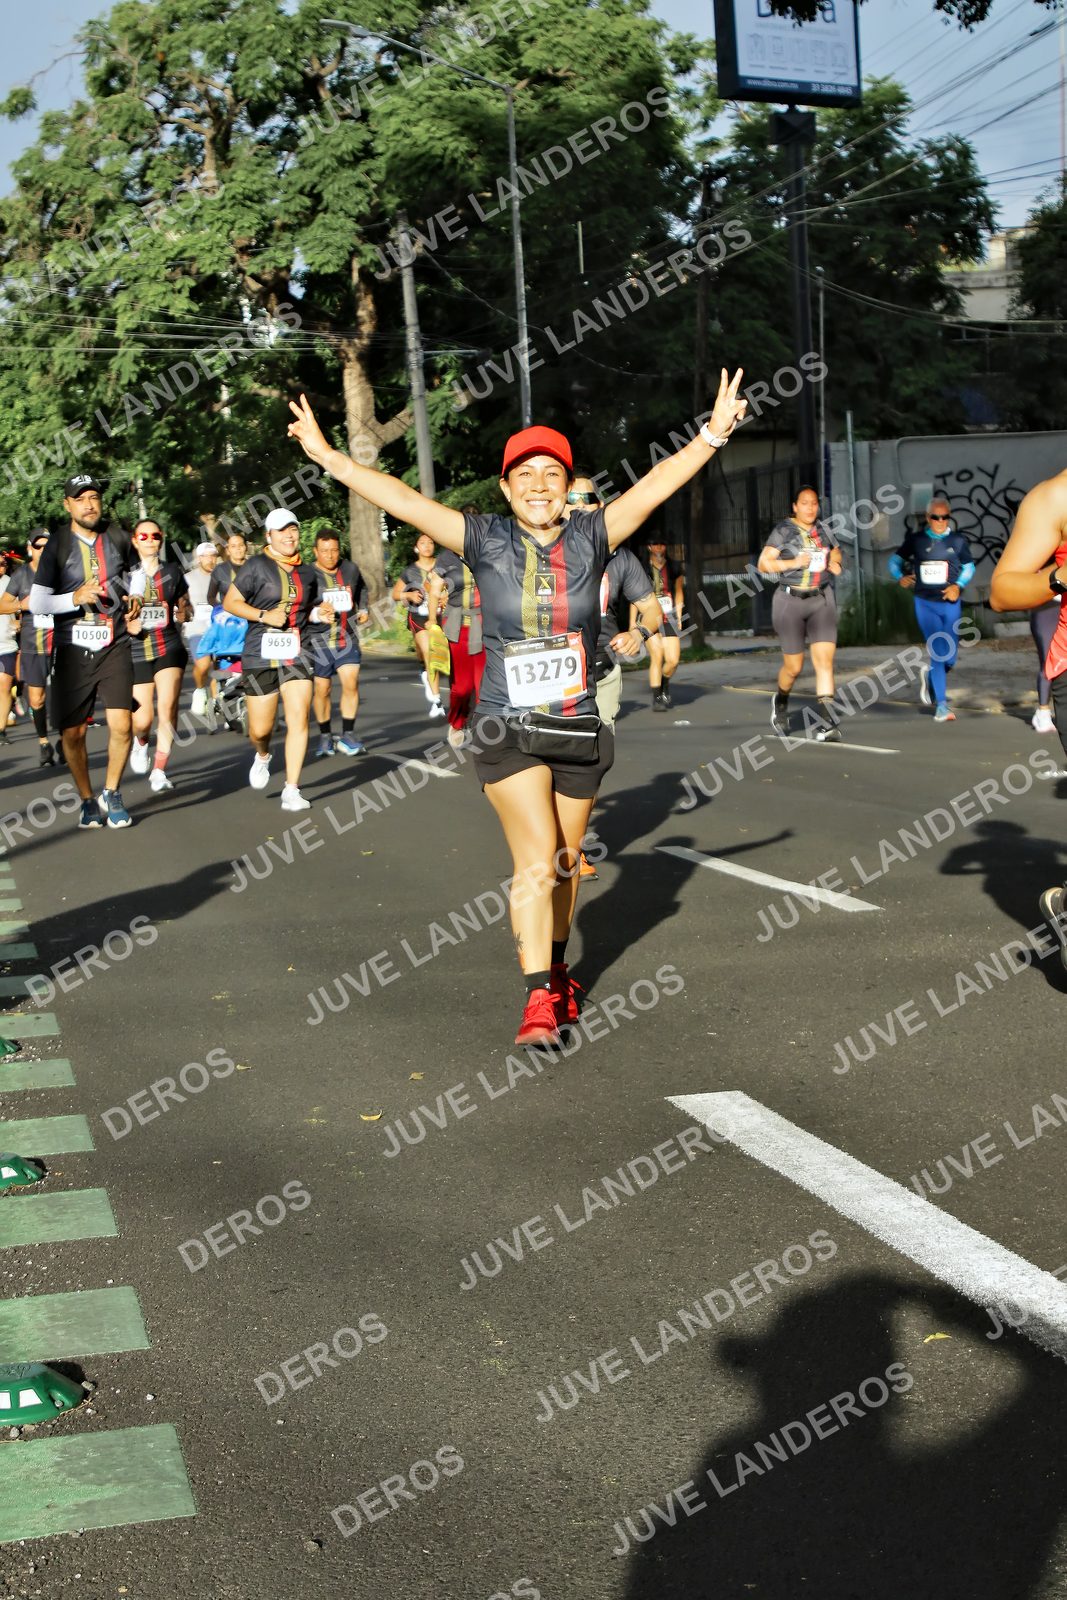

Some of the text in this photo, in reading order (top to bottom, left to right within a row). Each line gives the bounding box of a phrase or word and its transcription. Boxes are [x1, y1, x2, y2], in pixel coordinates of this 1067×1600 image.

[935, 464, 999, 489] TOY
[139, 609, 165, 620] 2124
[75, 630, 108, 640] 10500
[267, 637, 292, 647] 9659
[511, 656, 577, 685] 13279
